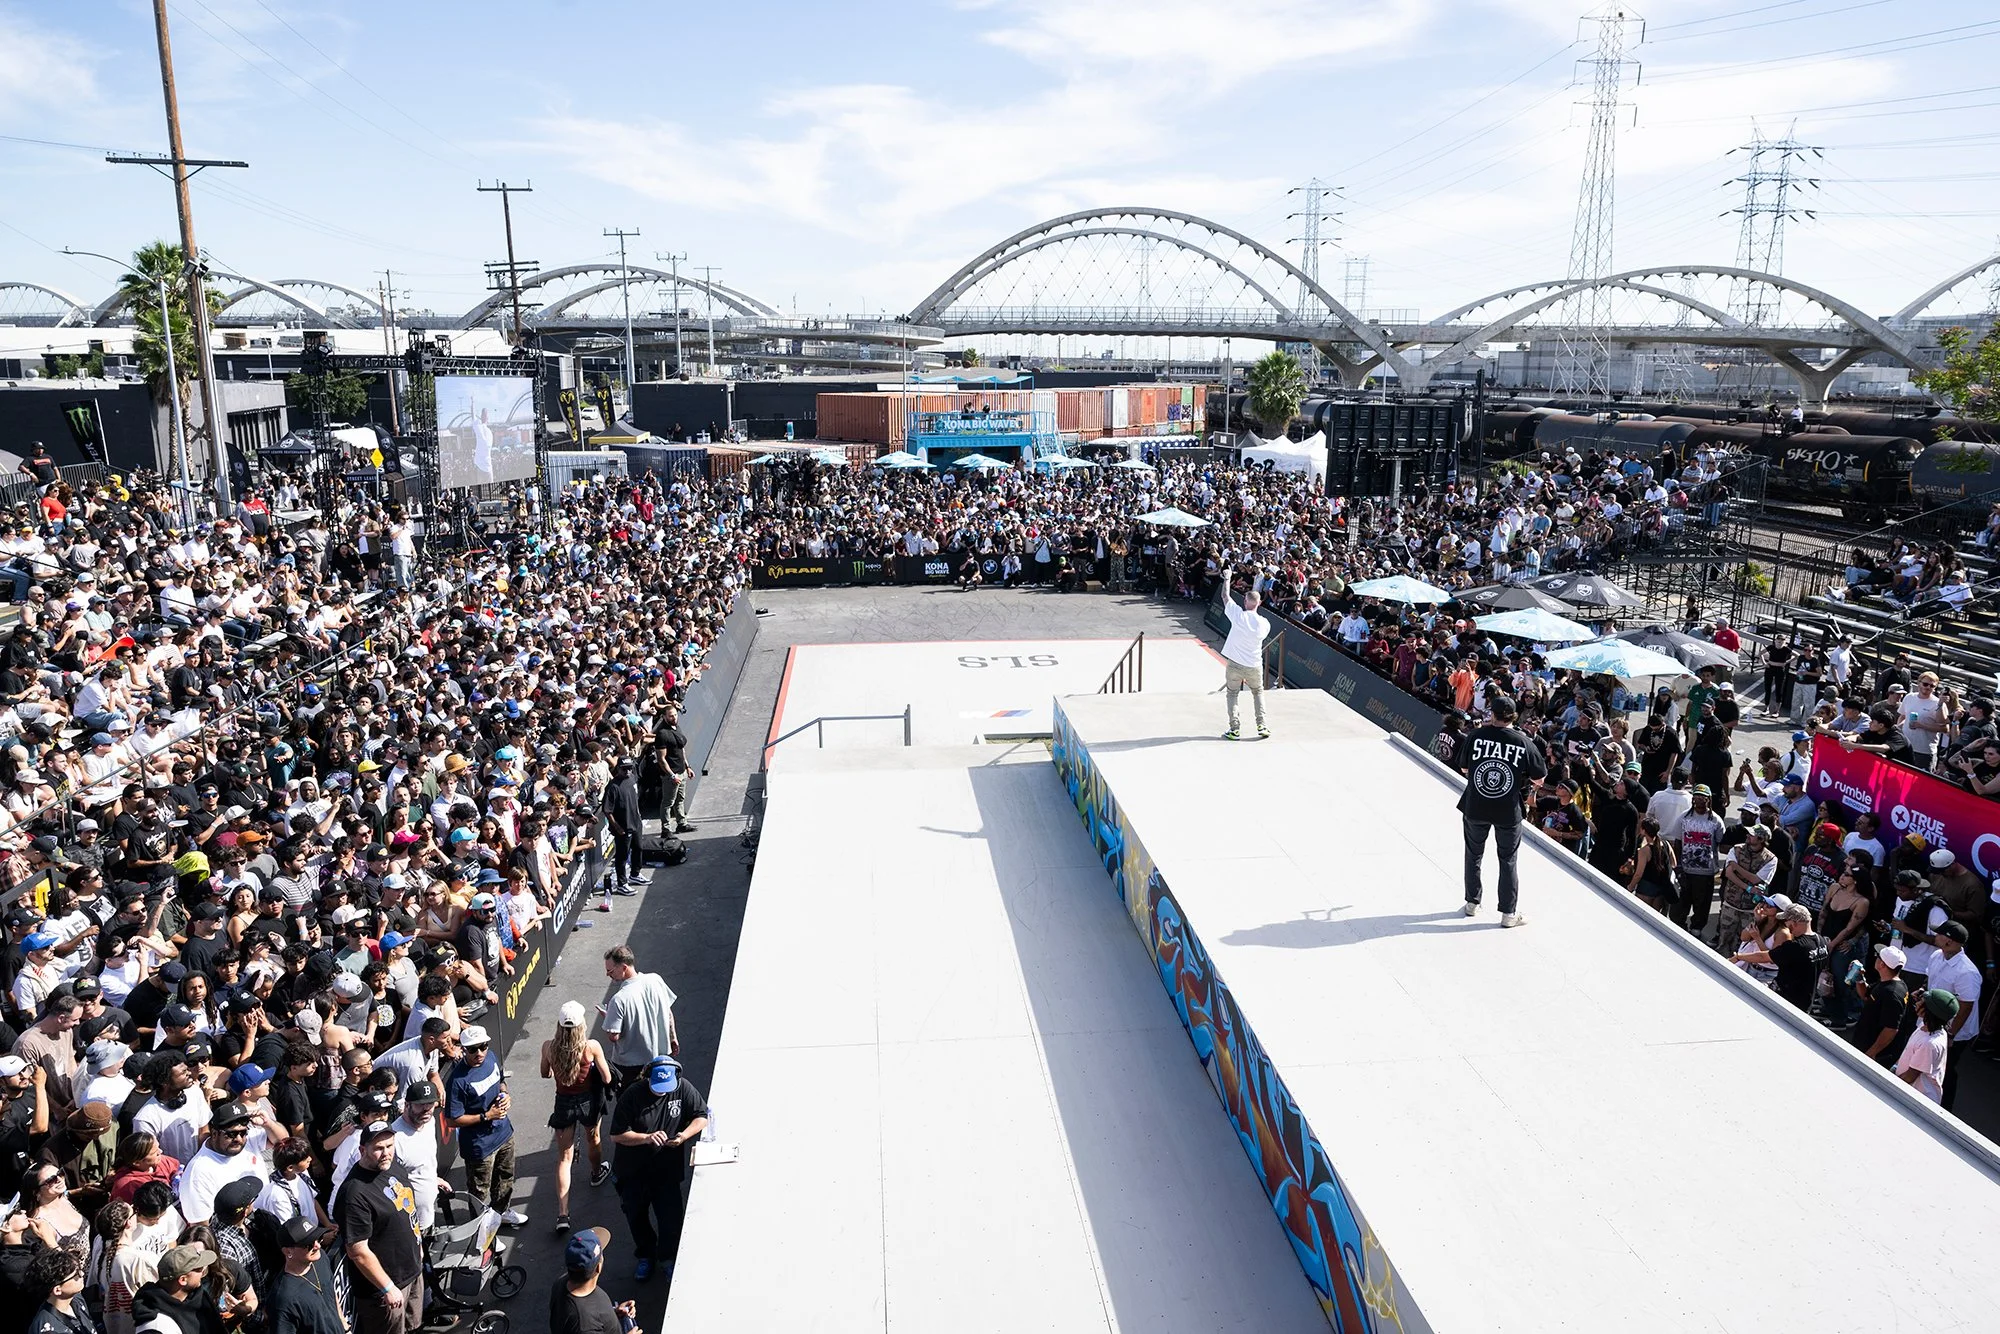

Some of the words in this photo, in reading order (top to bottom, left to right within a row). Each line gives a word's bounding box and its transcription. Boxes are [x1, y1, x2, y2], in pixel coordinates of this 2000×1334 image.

[944, 420, 971, 429] KONA
[972, 420, 988, 429] BIG
[989, 420, 1016, 429] WAVE
[924, 562, 949, 571] KONA
[957, 654, 1059, 669] SLS
[1333, 672, 1358, 694] KONA
[1472, 738, 1526, 768] STAFF
[1834, 780, 1873, 806] rumble
[1910, 809, 1946, 836] TRUE
[1907, 822, 1949, 850] SKATE
[517, 947, 541, 996] RAM
[422, 1085, 432, 1097] B
